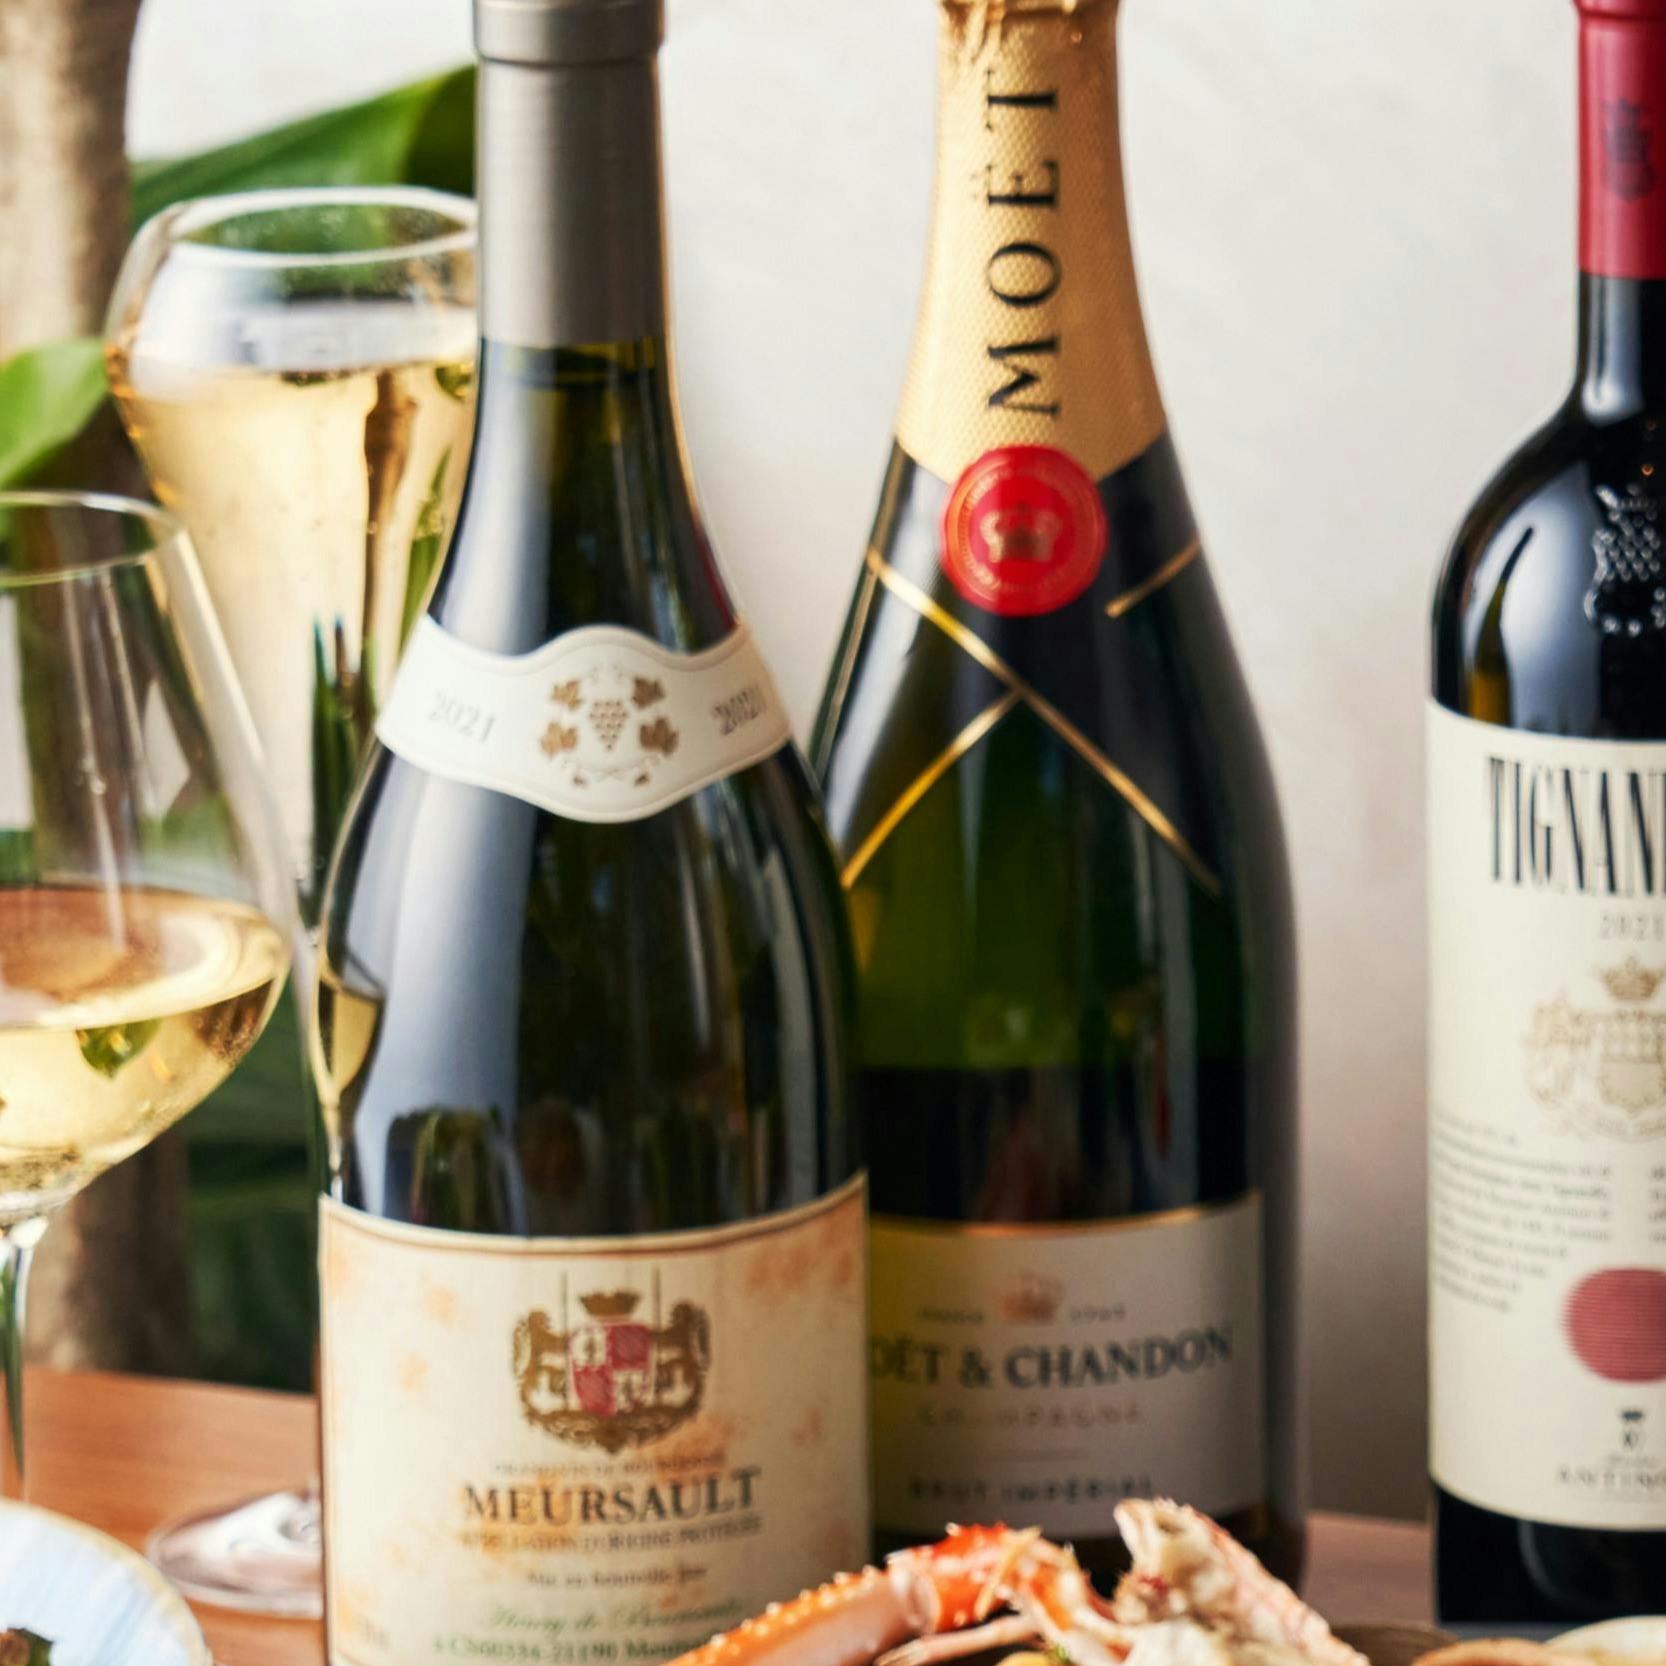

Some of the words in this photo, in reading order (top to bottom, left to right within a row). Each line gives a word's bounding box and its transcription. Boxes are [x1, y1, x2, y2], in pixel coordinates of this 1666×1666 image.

[974, 68, 1062, 420] MOËT
[429, 688, 497, 747] 2021
[1600, 911, 1665, 941] 2021
[959, 1344, 993, 1389] &
[1007, 1325, 1233, 1389] CHANDON
[463, 1465, 763, 1523] MEURSAULT
